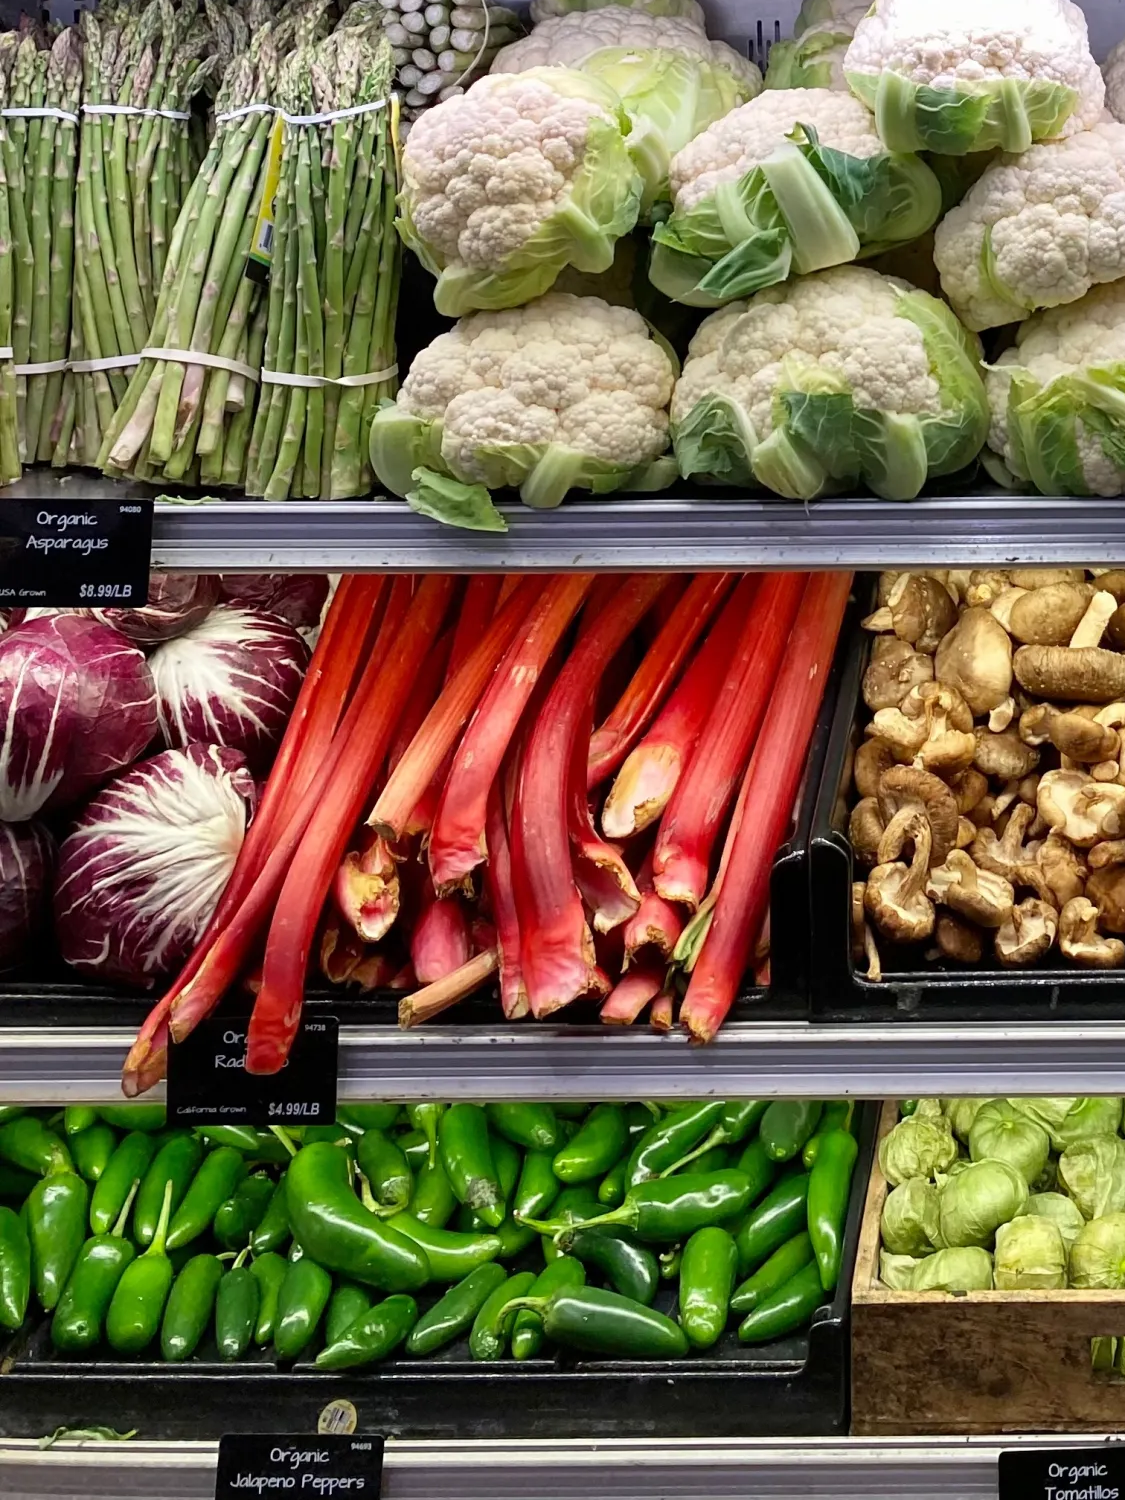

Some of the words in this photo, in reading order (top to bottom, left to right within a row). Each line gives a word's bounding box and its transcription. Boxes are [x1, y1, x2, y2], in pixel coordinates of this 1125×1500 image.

[37, 511, 98, 532] Organic
[26, 535, 109, 555] Asparagus
[80, 584, 132, 598] $8.99/LB
[177, 1106, 217, 1114] California
[268, 1103, 320, 1116] $4.99/LB
[270, 1448, 330, 1469] Organic
[1048, 1462, 1108, 1484] Organic
[230, 1473, 295, 1494] Jalapeno
[301, 1474, 365, 1495] Peppers
[1044, 1485, 1119, 1500] Tomatillos
